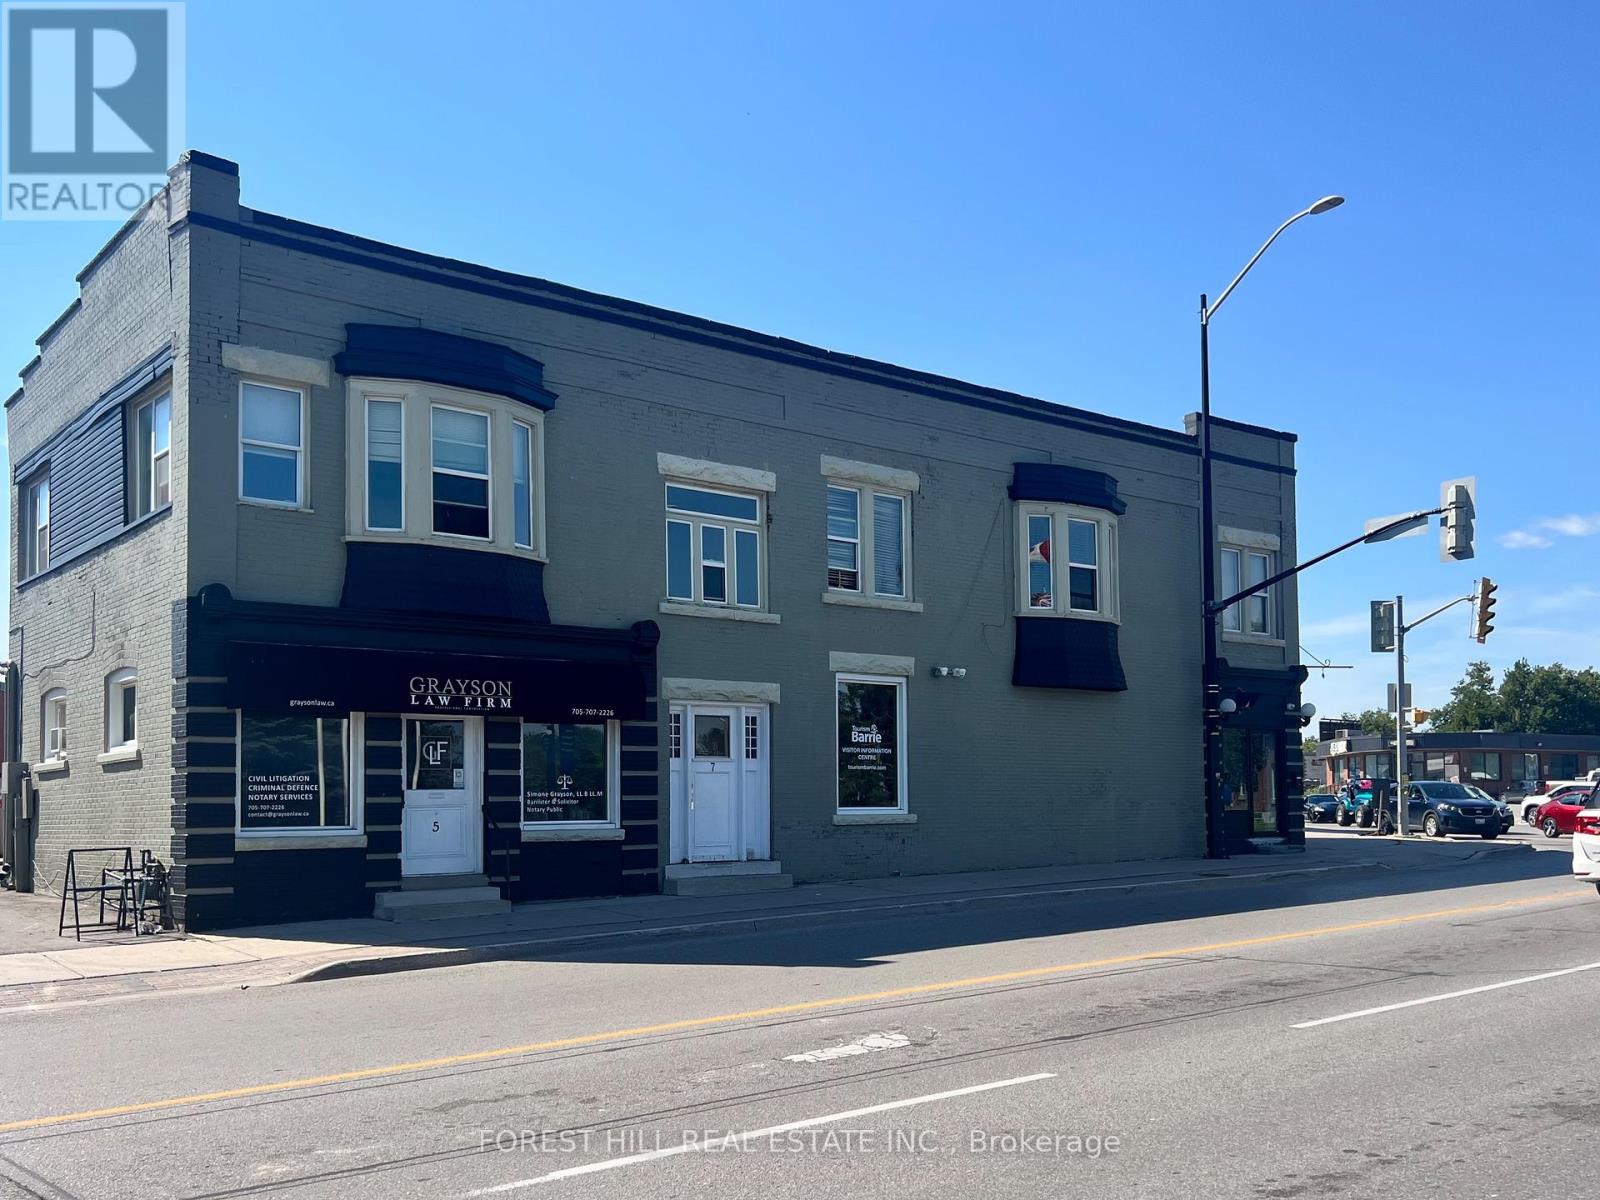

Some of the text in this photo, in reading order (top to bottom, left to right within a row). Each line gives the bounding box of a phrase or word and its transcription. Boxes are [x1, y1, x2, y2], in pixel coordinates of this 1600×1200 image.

[409, 676, 513, 697] GRAYSON
[289, 699, 335, 707] graysonlaw.ca
[410, 694, 451, 706] LAW
[464, 697, 512, 708] FIRM
[571, 708, 614, 716] 705-707-2226
[851, 731, 882, 743] Barrie
[710, 762, 716, 772] 7
[248, 793, 278, 801] NOTARY
[432, 821, 440, 833] 5
